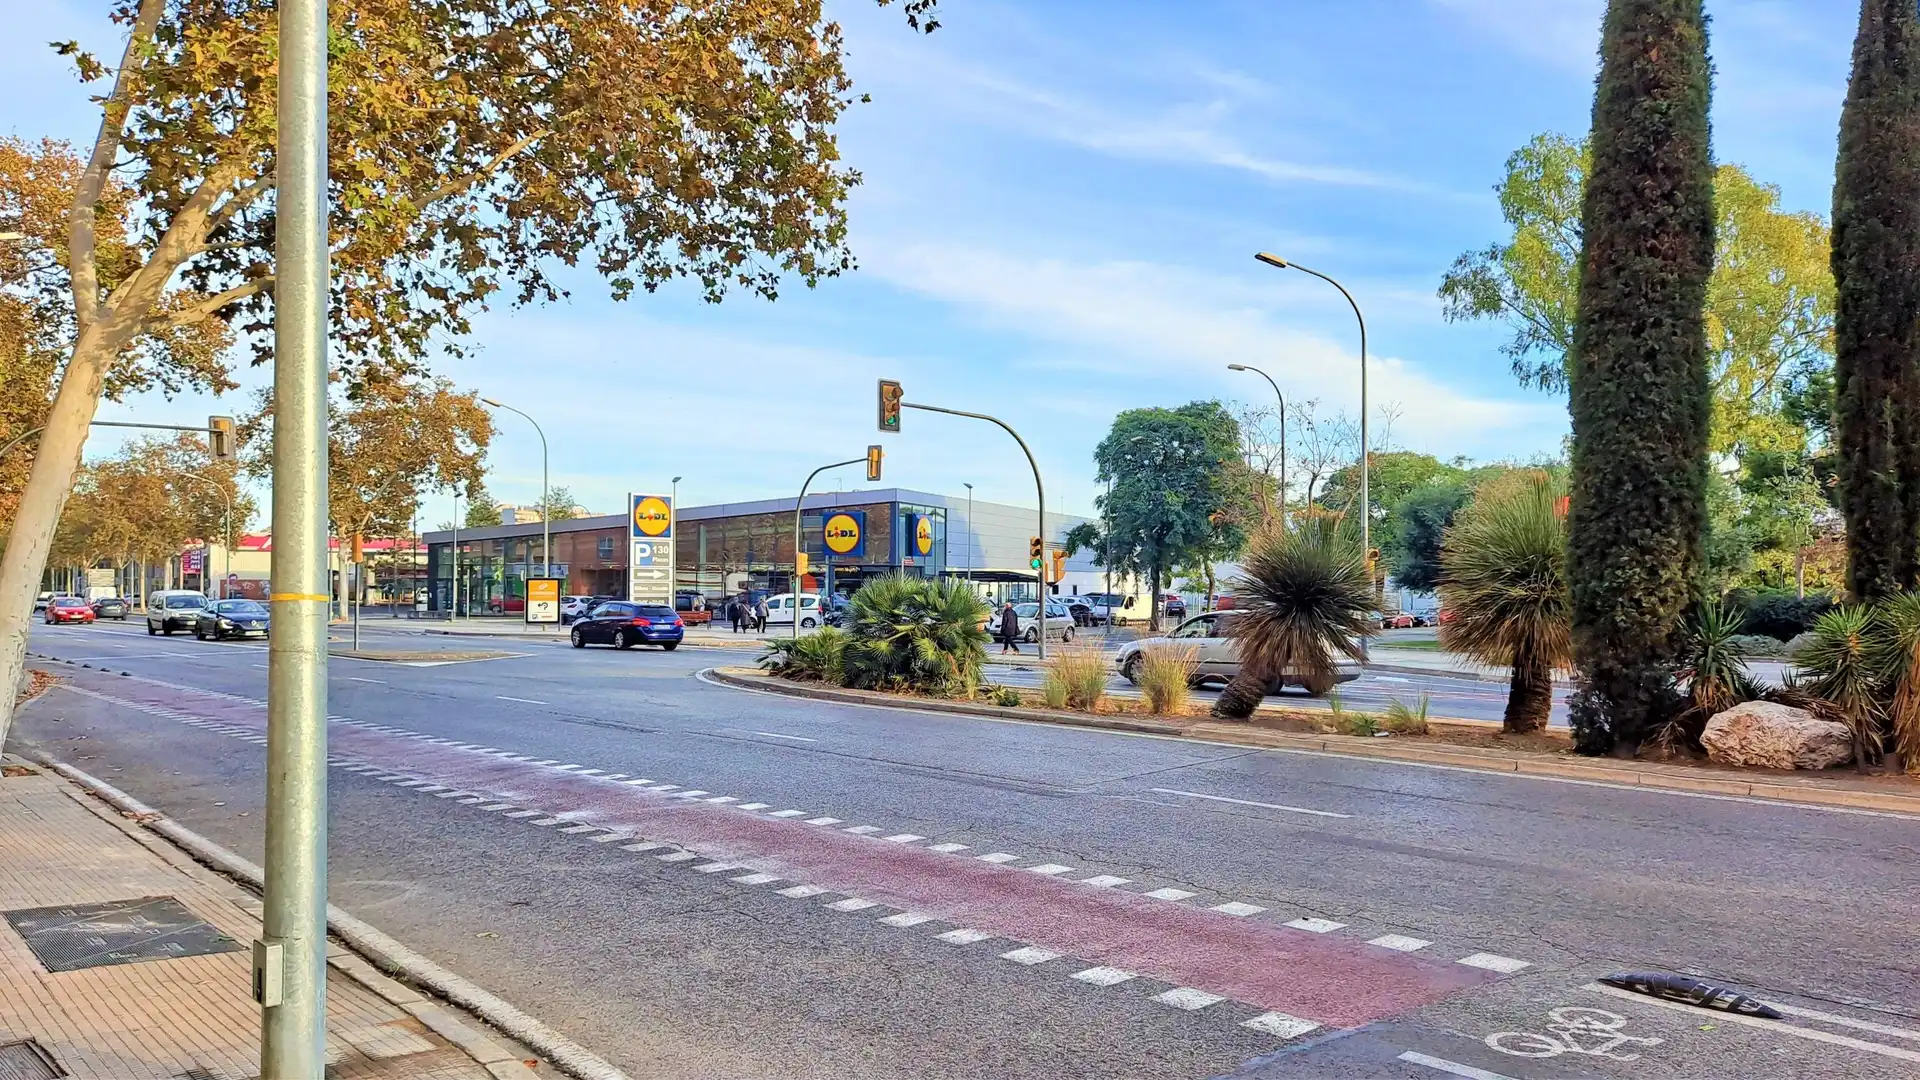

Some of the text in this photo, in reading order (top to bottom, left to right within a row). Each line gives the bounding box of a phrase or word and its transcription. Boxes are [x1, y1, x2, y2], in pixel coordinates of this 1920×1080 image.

[638, 510, 668, 522] LIDL
[826, 526, 856, 539] LIDL
[635, 543, 651, 565] P
[652, 545, 669, 554] 130
